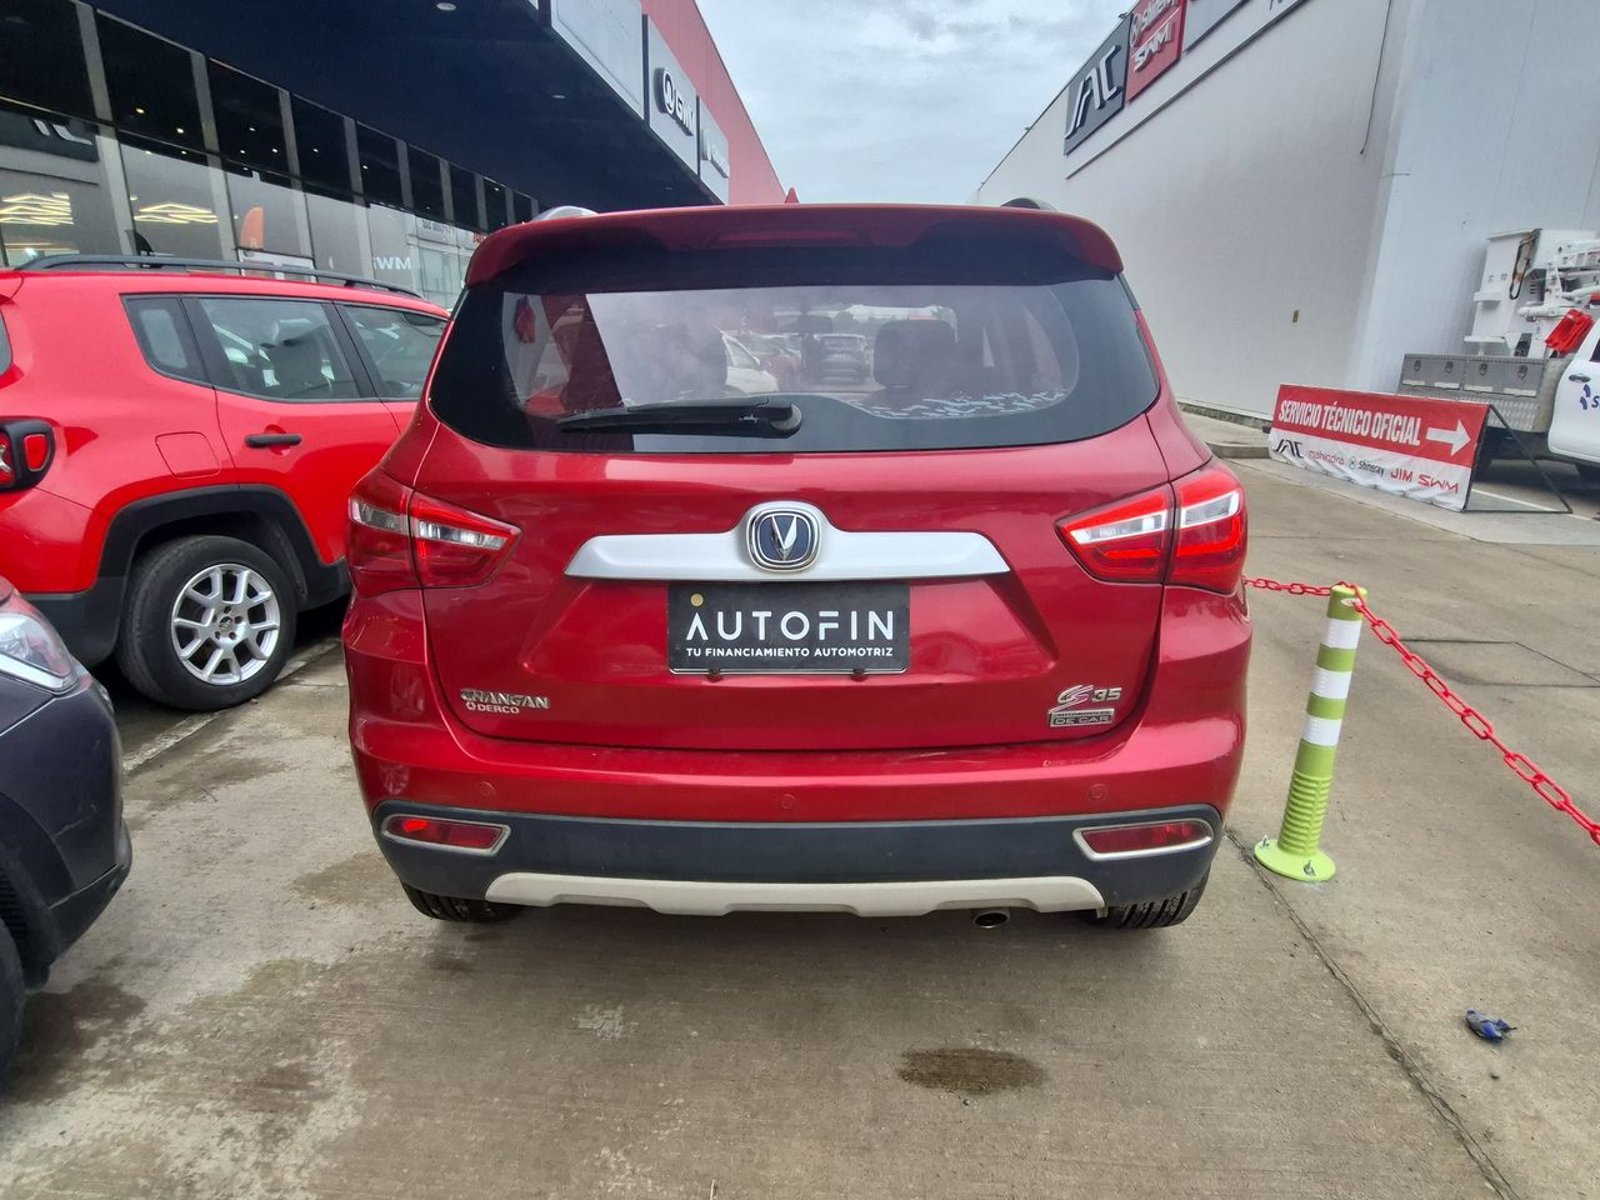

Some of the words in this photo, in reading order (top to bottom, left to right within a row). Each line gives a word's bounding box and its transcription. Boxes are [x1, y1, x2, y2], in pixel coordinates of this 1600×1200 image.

[1278, 399, 1322, 428] SERVICIO
[1321, 401, 1372, 436] TÉCNICO
[1371, 412, 1421, 446] OFICIAL
[1390, 468, 1413, 483] JIM
[1418, 473, 1459, 494] SWM
[686, 610, 893, 641] AUTOFIN
[686, 647, 702, 657] TU
[705, 647, 810, 657] FINANCIAMIENTO
[814, 647, 893, 657] AUTOMOTRIZ
[460, 688, 549, 709] CHANGAN
[477, 703, 520, 714] DERCO
